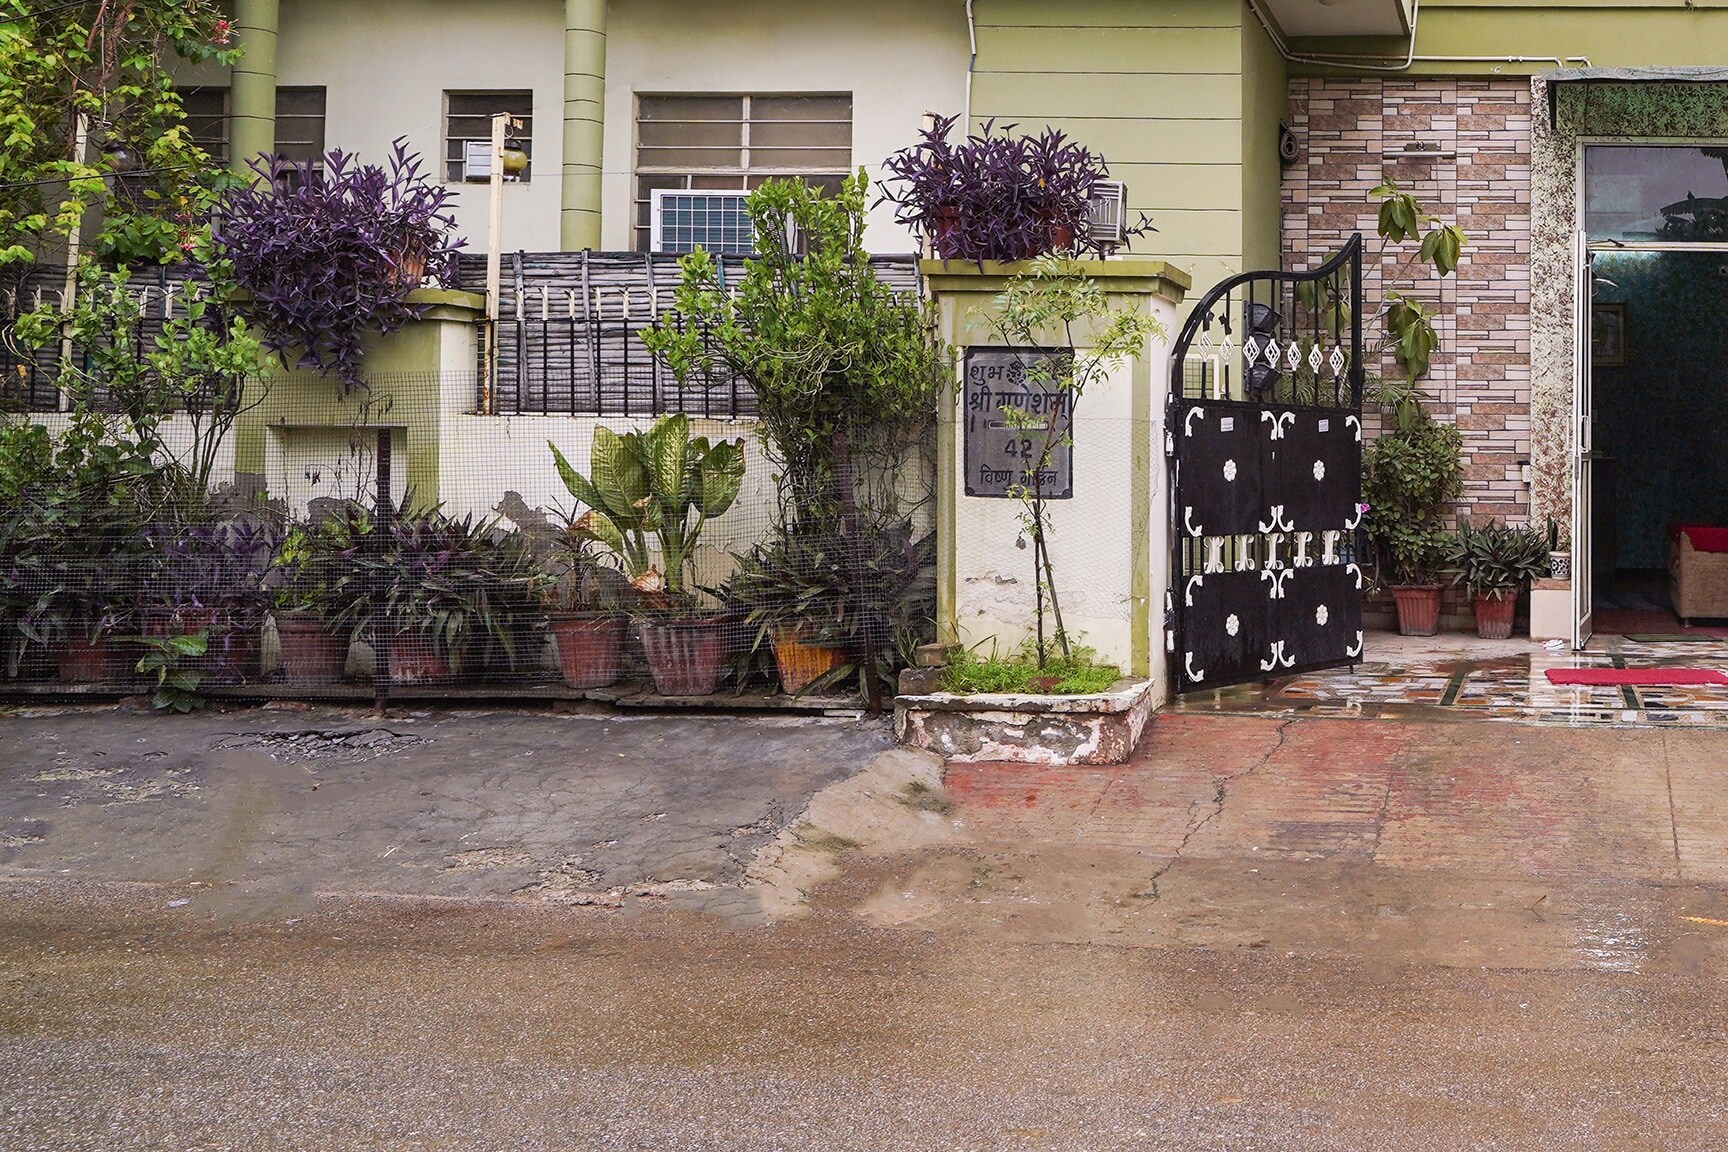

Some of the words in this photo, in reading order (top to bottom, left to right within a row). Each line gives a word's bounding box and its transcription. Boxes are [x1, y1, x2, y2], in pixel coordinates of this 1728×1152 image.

[969, 365, 1004, 386] शुभ
[969, 386, 992, 412] श्री
[1004, 439, 1033, 459] 42
[980, 464, 1013, 491] विष्णु
